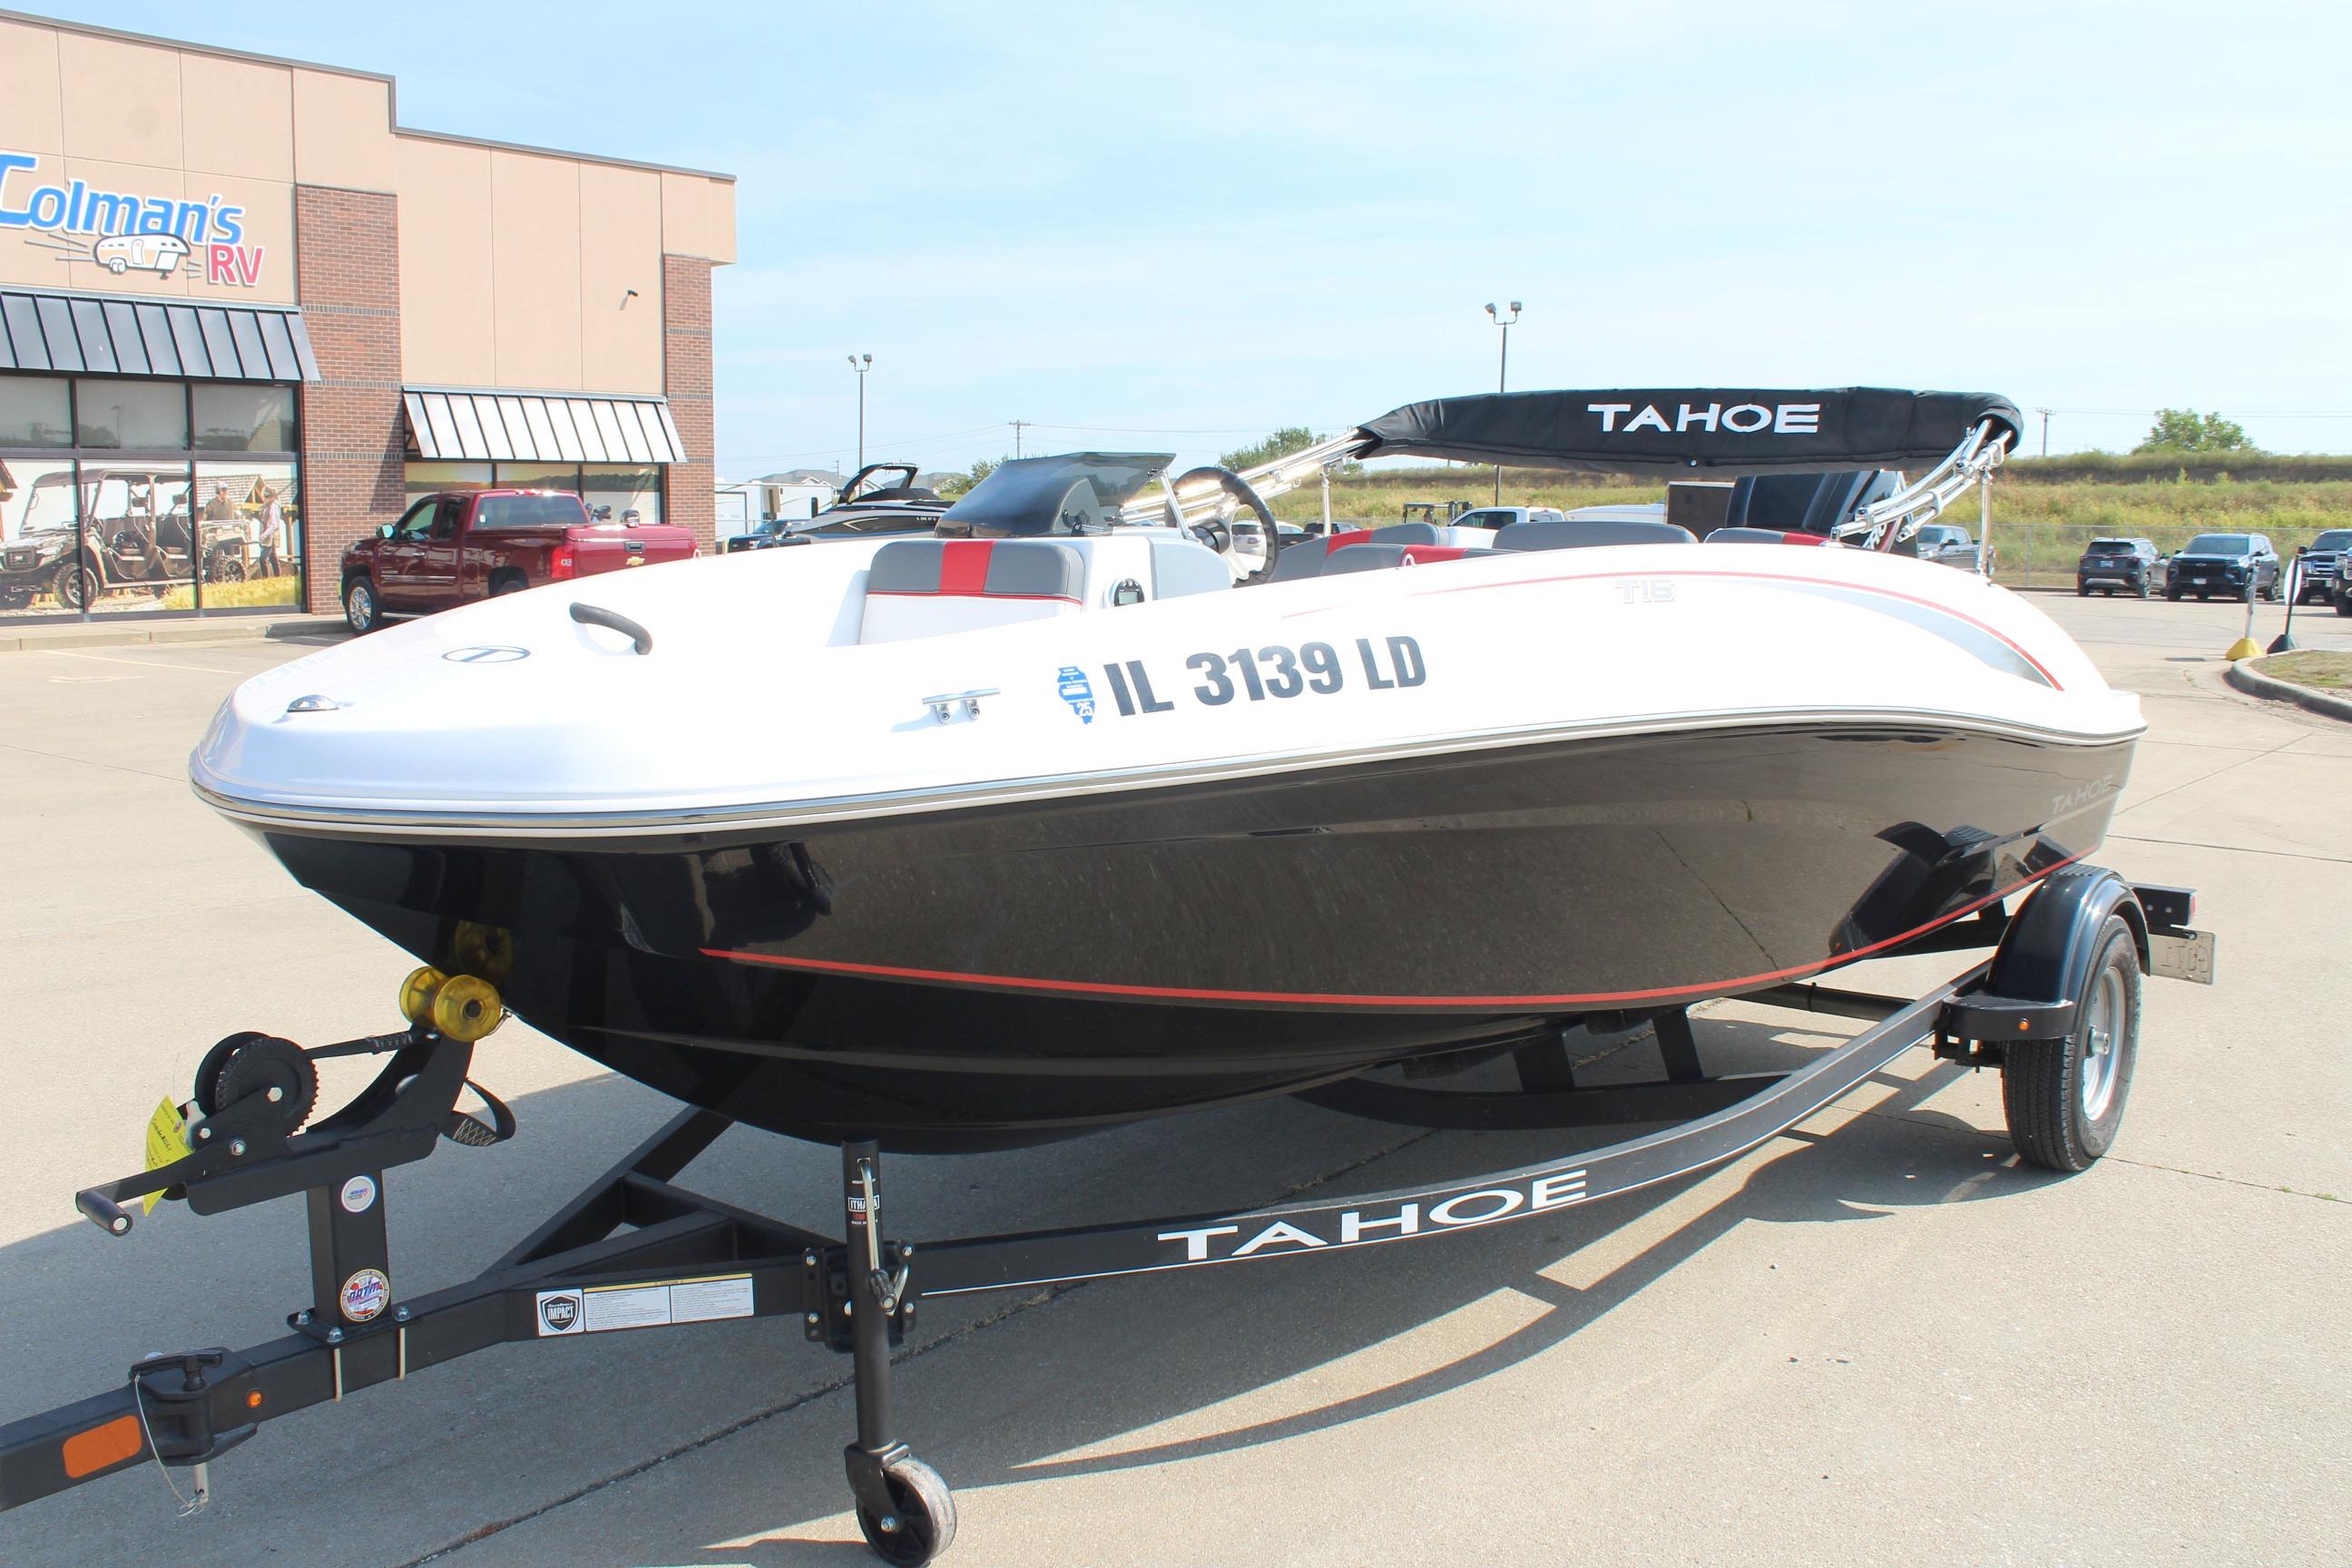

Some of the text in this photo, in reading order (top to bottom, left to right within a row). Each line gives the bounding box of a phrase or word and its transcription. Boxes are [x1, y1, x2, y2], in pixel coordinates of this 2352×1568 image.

[209, 243, 264, 285] RV
[1587, 402, 1821, 435] TAHOE
[1102, 635, 1427, 717] IL 3139 LD
[1076, 701, 1093, 717] 25
[2052, 773, 2114, 815] TAHOE
[1157, 1169, 1588, 1261] TAHOE
[547, 1305, 574, 1320] IMPACT
